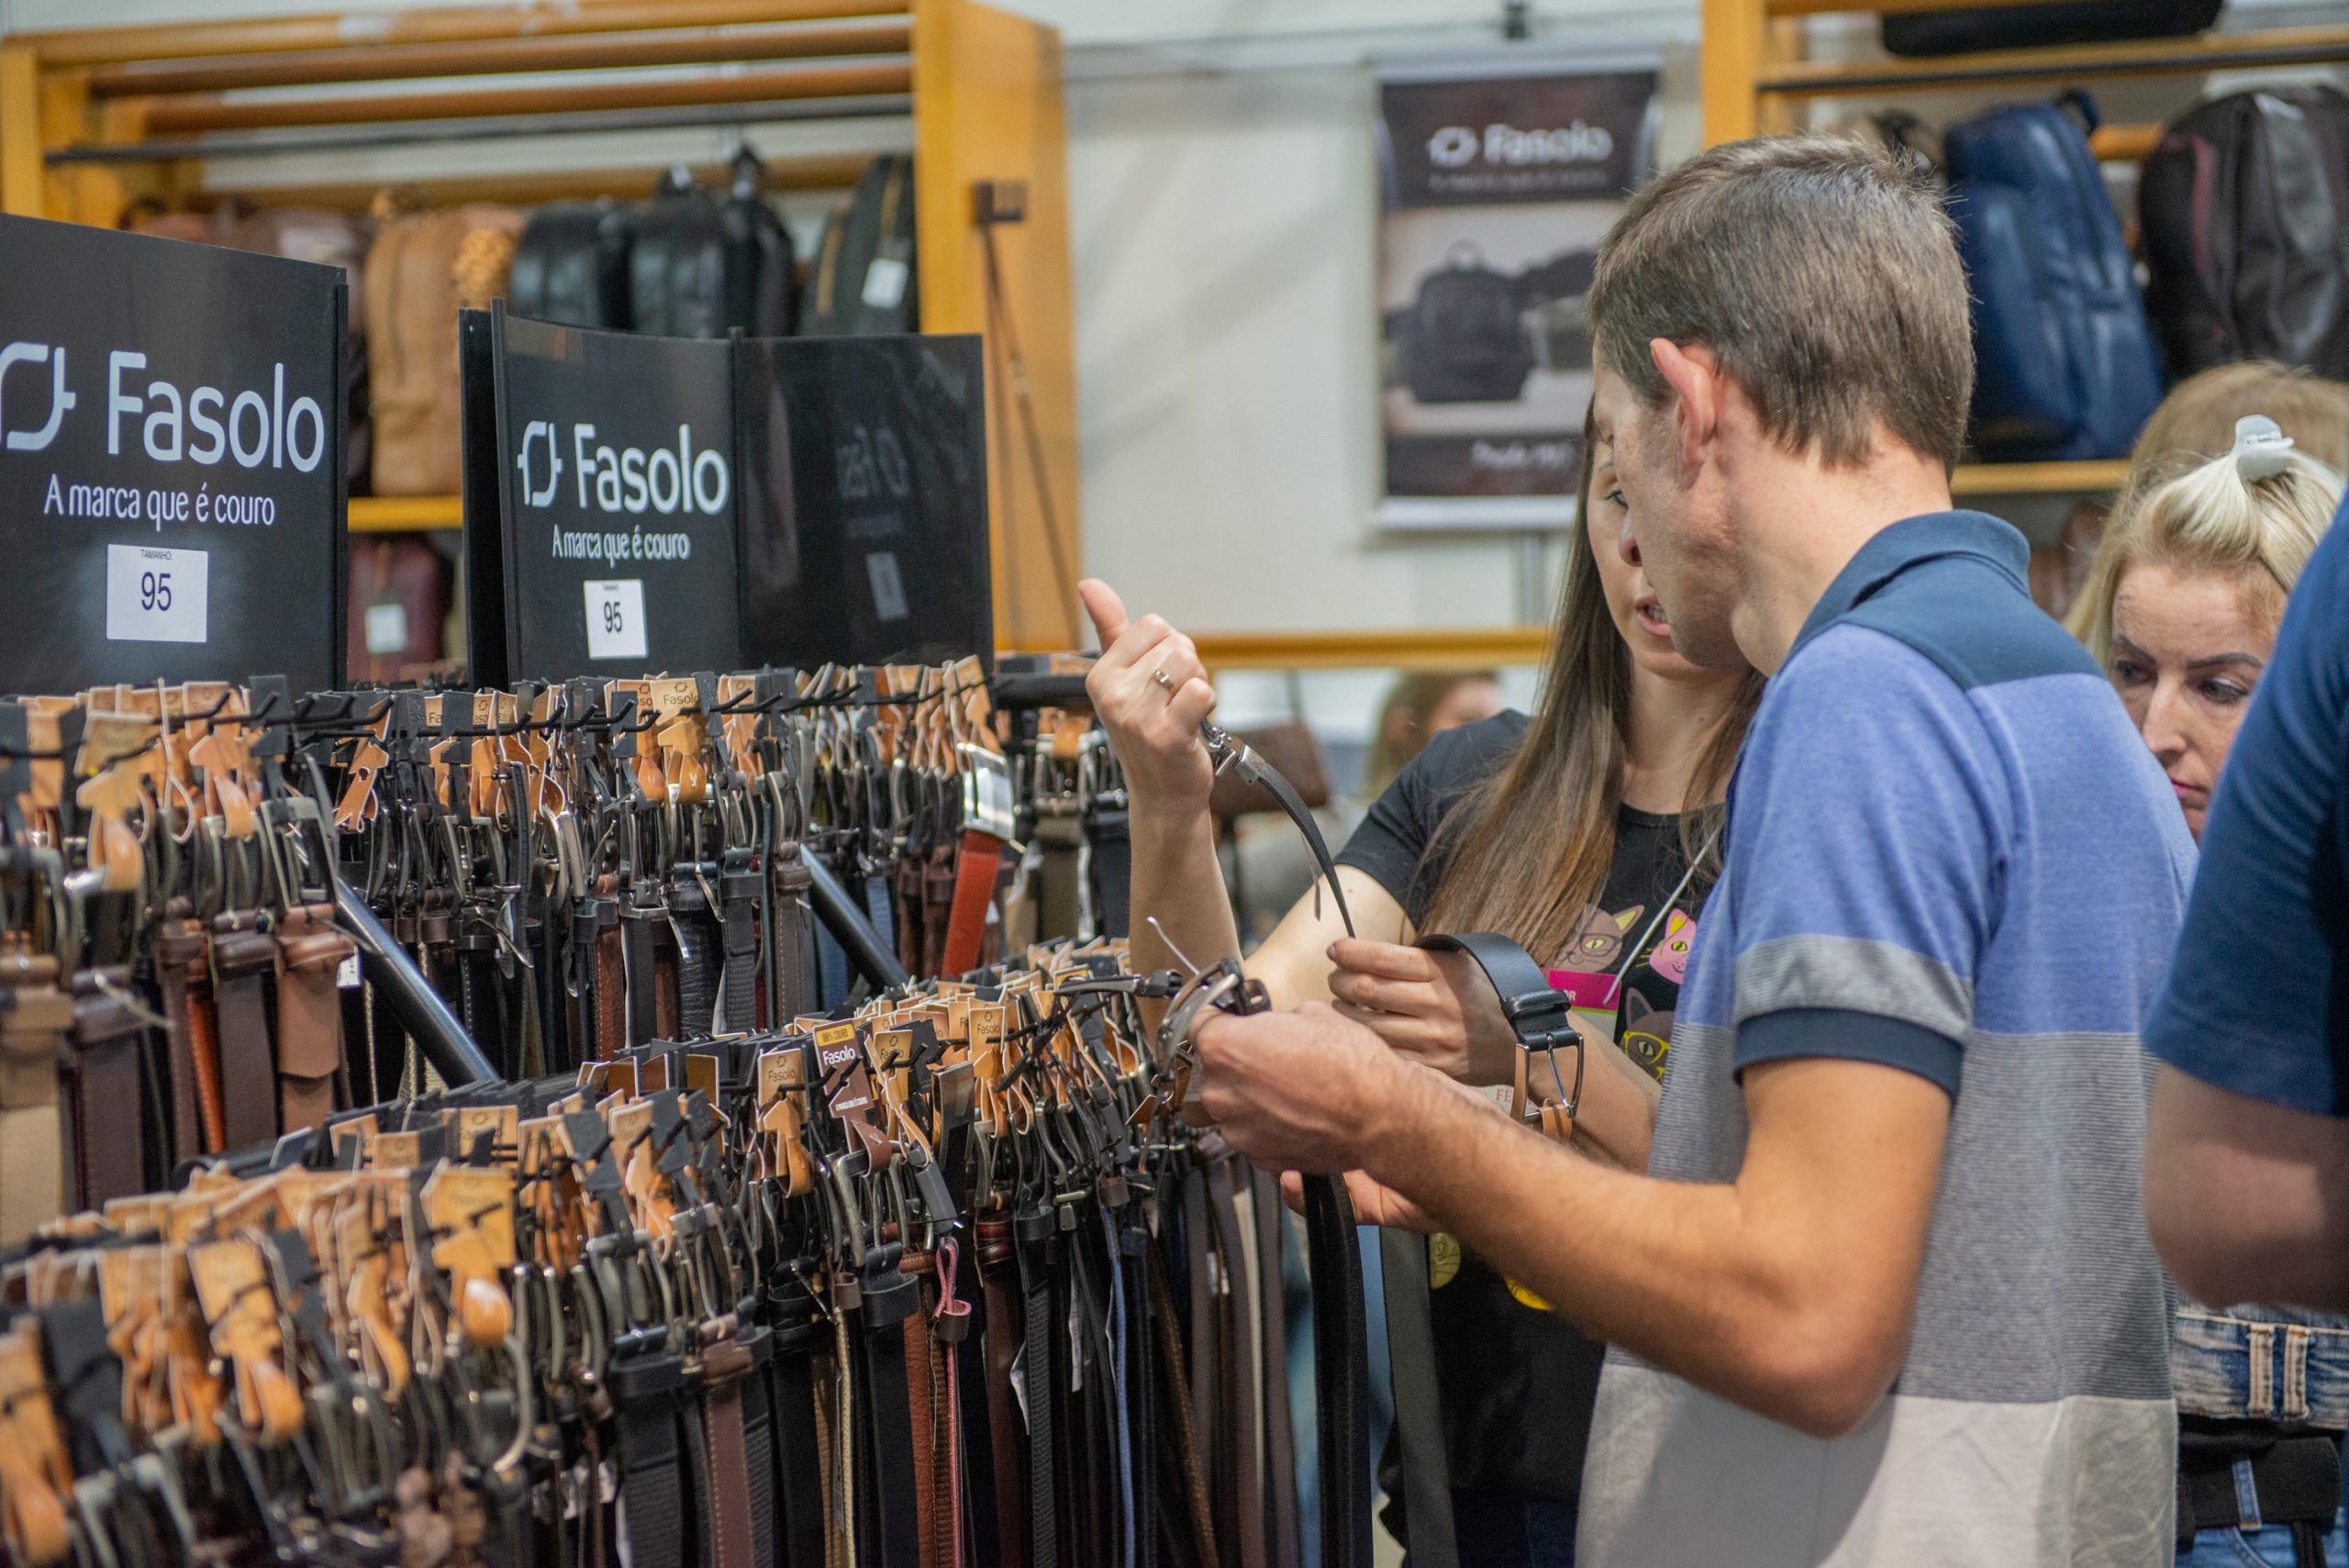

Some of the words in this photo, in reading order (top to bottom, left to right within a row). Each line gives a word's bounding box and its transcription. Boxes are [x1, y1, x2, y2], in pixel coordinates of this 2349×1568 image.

[107, 350, 325, 473] Fasolo
[573, 423, 730, 515] Fasolo
[44, 473, 64, 516] A
[69, 484, 140, 519] marca
[147, 490, 189, 532] que
[195, 482, 209, 523] é
[214, 494, 275, 526] couro
[552, 523, 563, 558] A
[563, 531, 603, 560] marca
[604, 532, 631, 569] que
[631, 524, 642, 560] é
[644, 532, 691, 561] couro
[141, 571, 173, 611] 95
[604, 601, 623, 633] 95
[977, 1023, 1000, 1035] Fasolo
[768, 1068, 796, 1083] Fasolo
[822, 1045, 855, 1066] Fasolo
